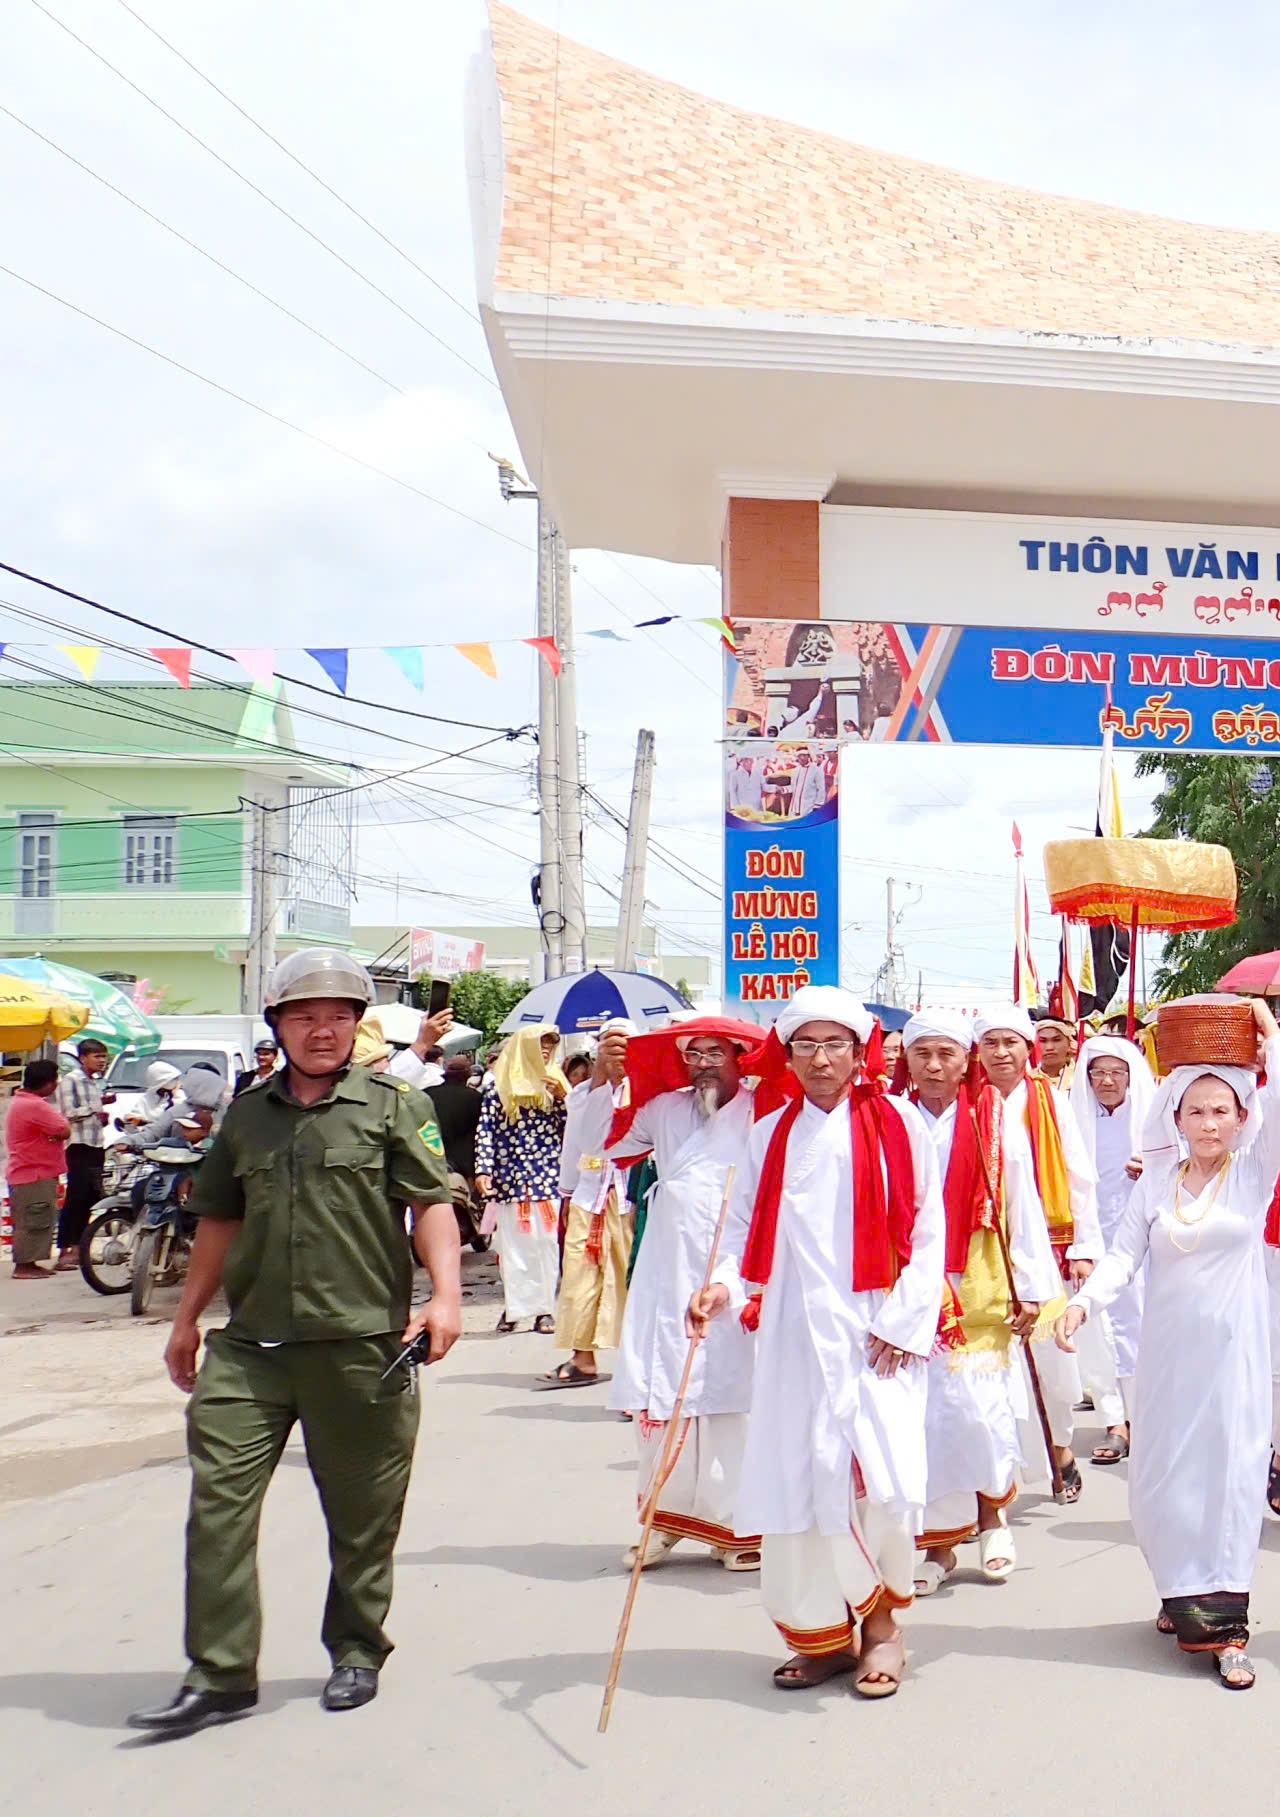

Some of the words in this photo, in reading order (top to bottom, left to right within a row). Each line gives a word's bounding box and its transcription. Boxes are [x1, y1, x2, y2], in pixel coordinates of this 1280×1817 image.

[1019, 536, 1148, 576] THÔN
[1165, 542, 1259, 581] VĂN
[991, 644, 1115, 684] ĐÓN
[746, 844, 804, 878] ĐÓN
[732, 886, 818, 919] MỪNG
[732, 923, 766, 960] LỄ
[771, 926, 818, 965] HỘI
[740, 968, 809, 1001] KATÊ
